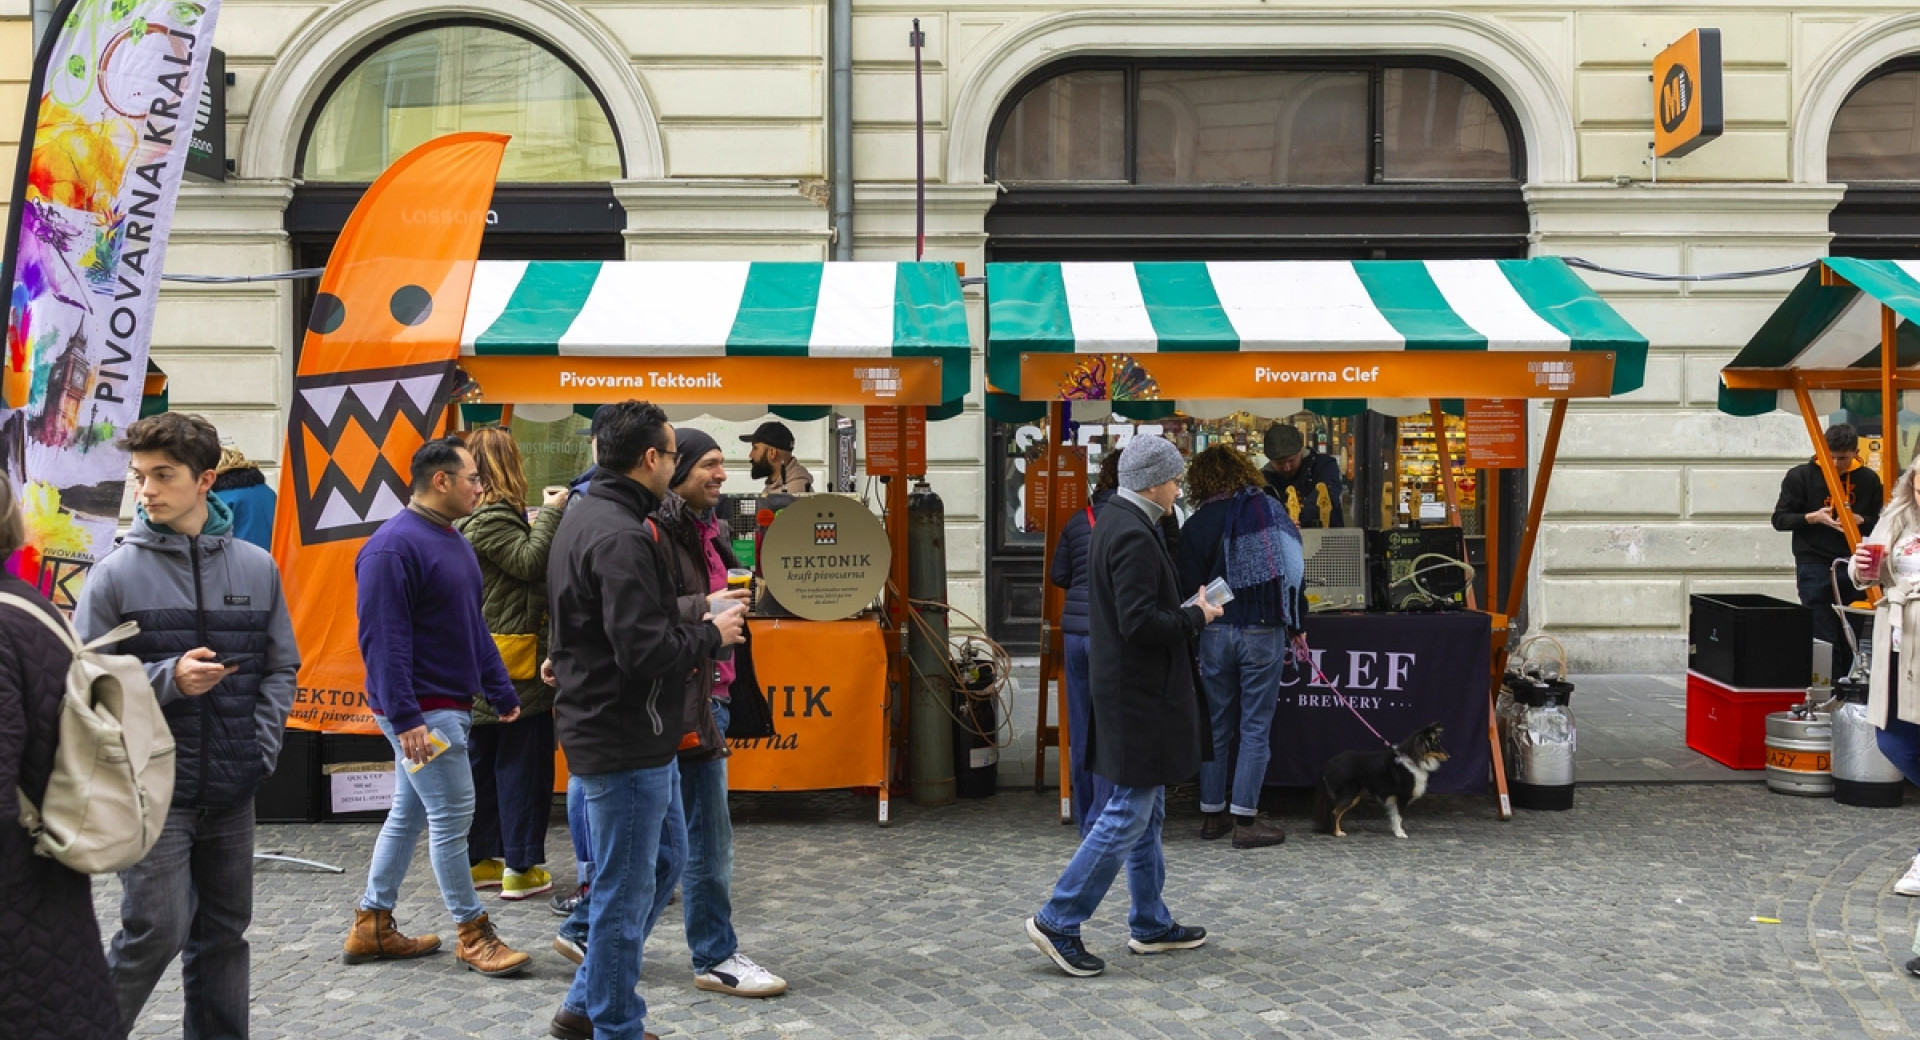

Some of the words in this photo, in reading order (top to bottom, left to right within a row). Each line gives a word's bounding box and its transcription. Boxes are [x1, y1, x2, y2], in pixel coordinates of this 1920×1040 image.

[95, 160, 168, 405] PIVOVARNA
[143, 28, 197, 145] KRALJ
[560, 371, 644, 388] Pivovarna
[648, 371, 723, 388] Tektonik
[1255, 366, 1337, 382] Pivovarna
[1342, 366, 1380, 382] Clef
[43, 548, 95, 561] PIVOVARNA
[781, 554, 871, 569] TEKTONIK
[1298, 694, 1382, 709] BREWERY
